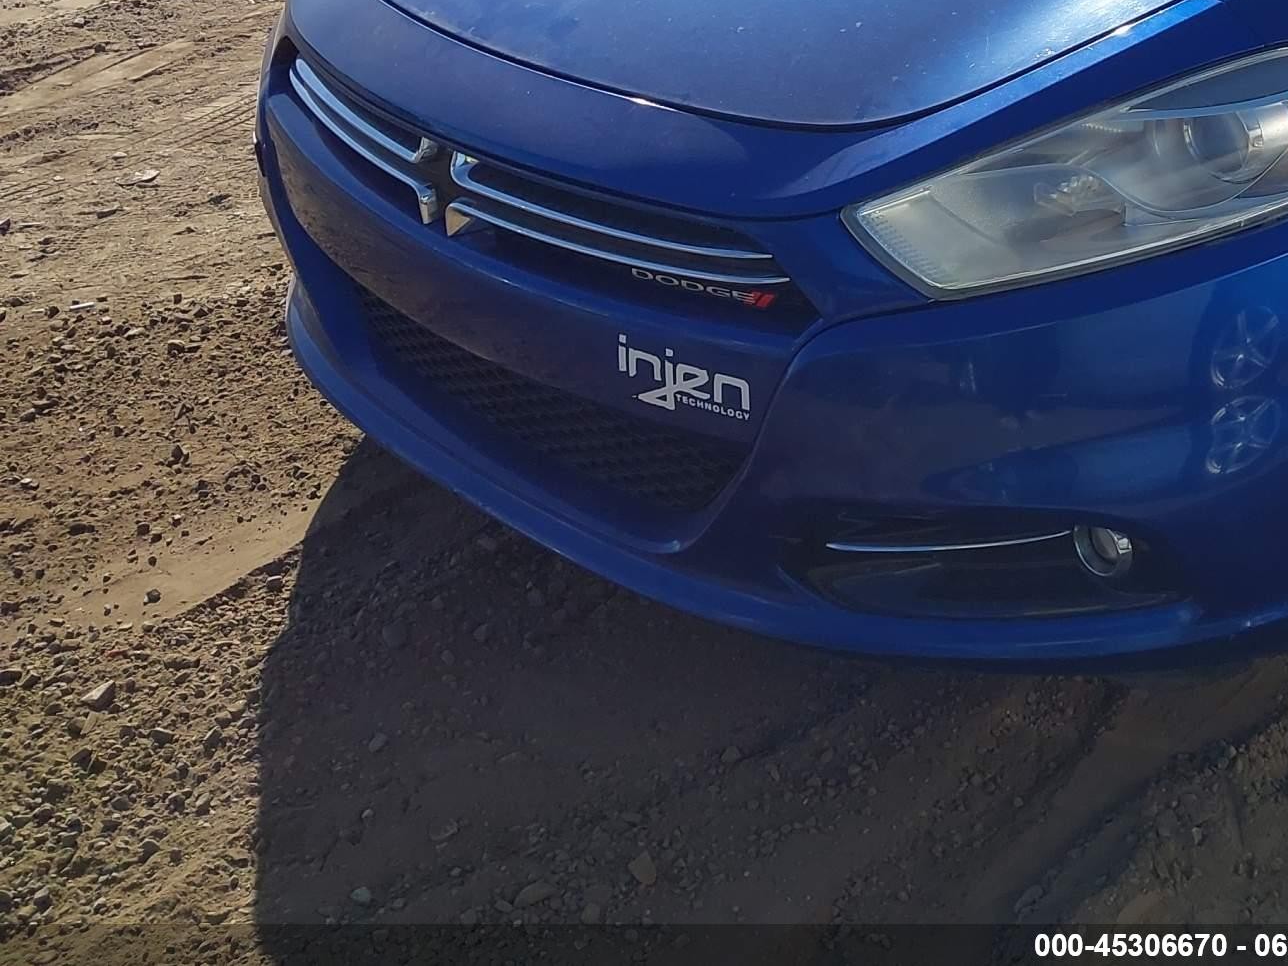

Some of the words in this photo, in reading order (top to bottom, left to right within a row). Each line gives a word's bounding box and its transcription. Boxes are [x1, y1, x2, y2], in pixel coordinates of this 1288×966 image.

[632, 267, 757, 305] DODGE
[618, 334, 750, 411] injen
[675, 392, 751, 421] TECHNOLOGY
